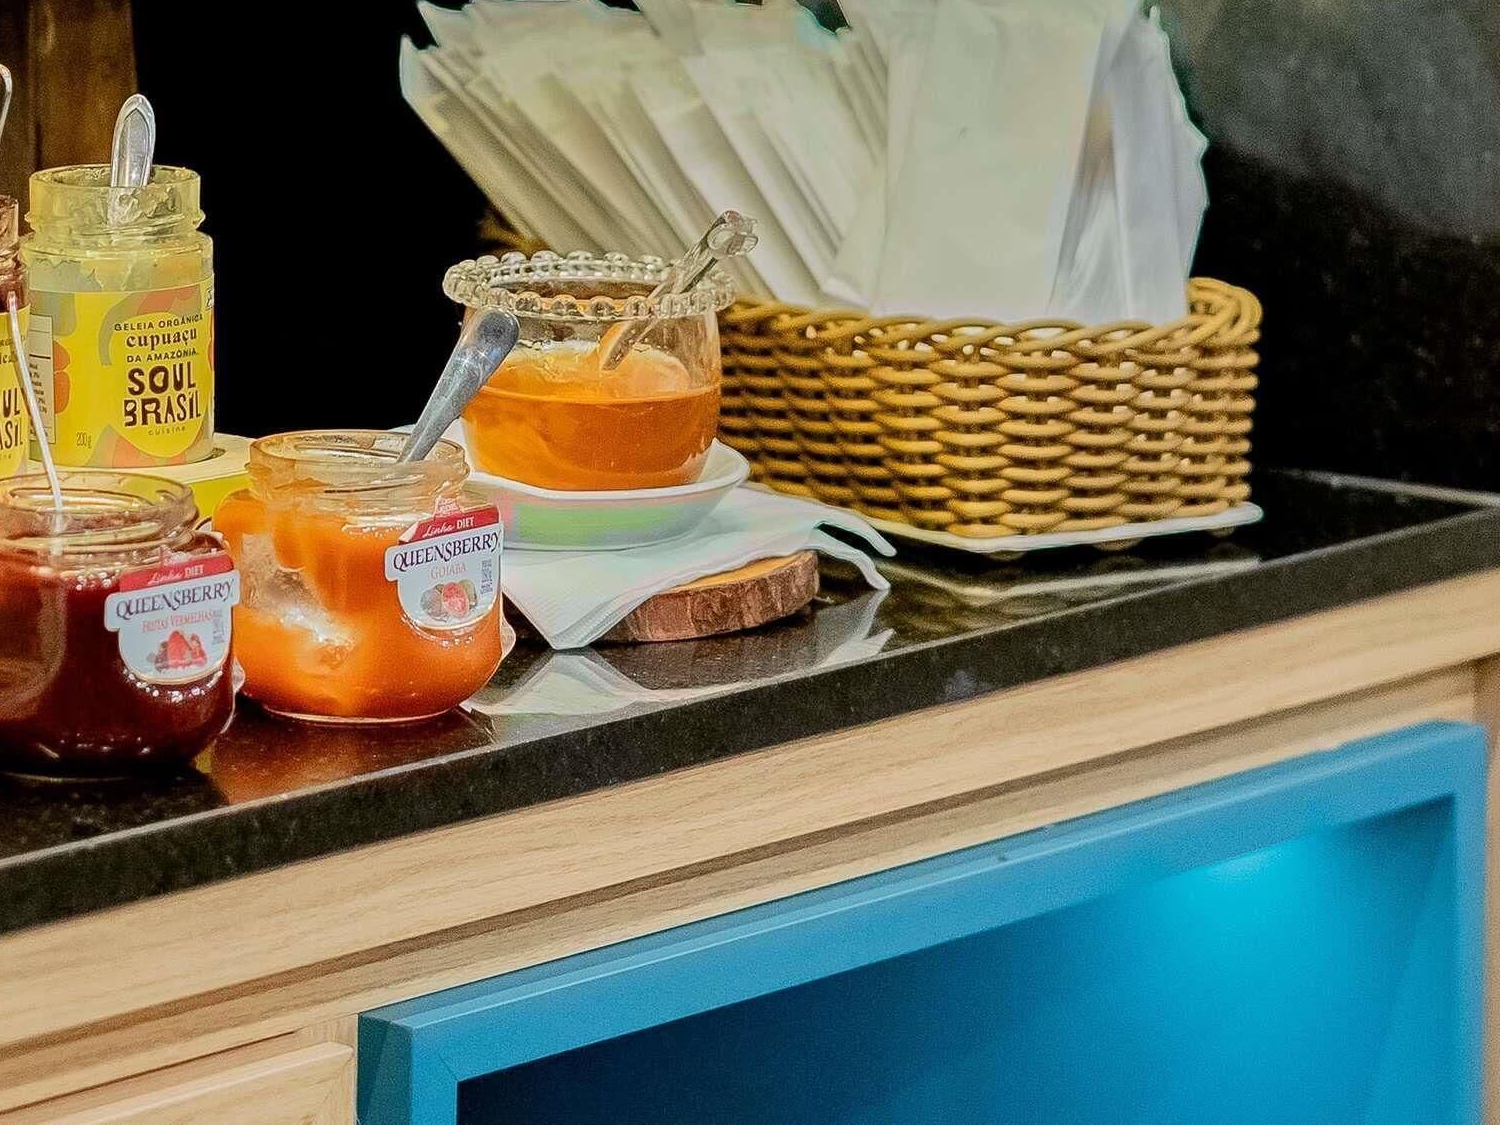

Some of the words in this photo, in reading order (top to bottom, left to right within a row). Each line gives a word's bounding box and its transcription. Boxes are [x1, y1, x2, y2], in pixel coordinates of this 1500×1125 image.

[114, 322, 154, 332] GELEIA
[126, 328, 197, 351] cupuaçu
[127, 355, 142, 363] DA
[147, 347, 197, 363] AMAZÔNIA
[127, 361, 196, 396] SOUL
[148, 425, 186, 436] cuisine
[421, 523, 455, 540] Linha
[457, 516, 475, 530] DIET
[393, 529, 501, 572] QUEENSBERRY
[185, 562, 205, 577] DIET
[116, 577, 234, 621] QUEENSBERRY
